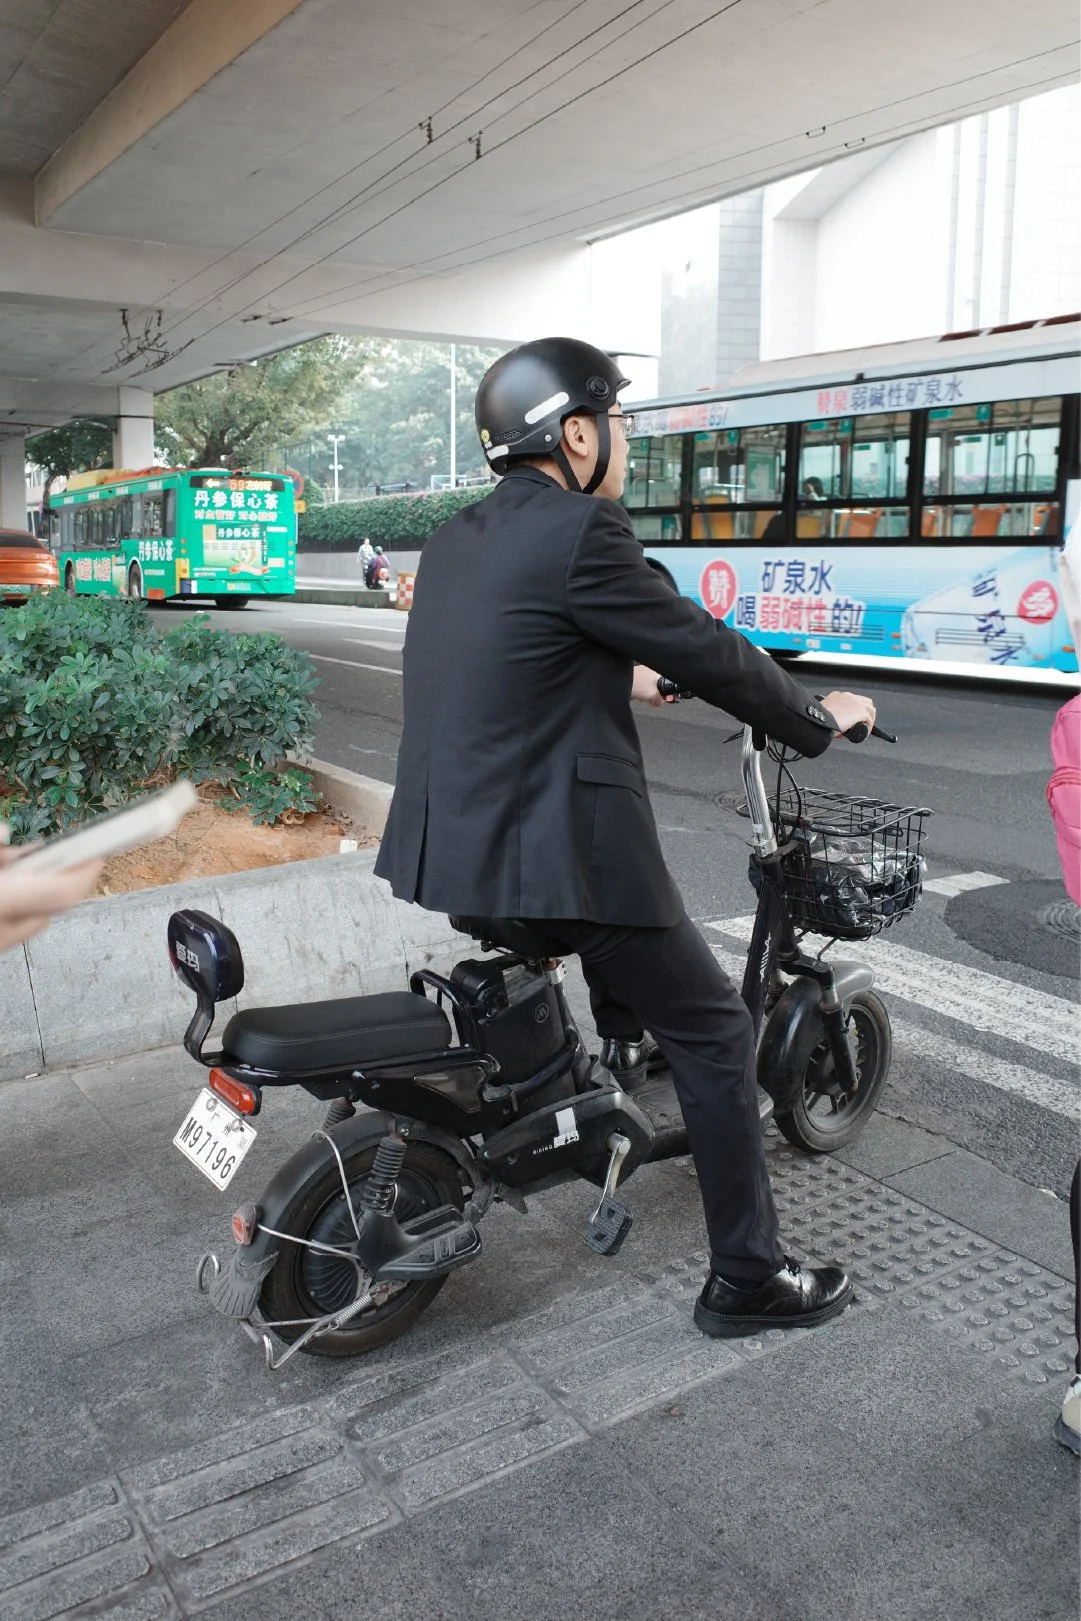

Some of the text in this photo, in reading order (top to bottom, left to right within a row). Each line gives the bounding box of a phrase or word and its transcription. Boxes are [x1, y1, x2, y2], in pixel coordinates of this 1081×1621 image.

[851, 375, 963, 411] 弱碱性矿泉水
[194, 490, 278, 510] 丹参保心茶
[138, 539, 173, 562] 丹参保心茶
[218, 527, 260, 539] 丹参保心茶
[761, 559, 834, 595] 矿泉水
[737, 595, 862, 633] 喝弱碱性的!
[179, 1116, 236, 1179] M97196
